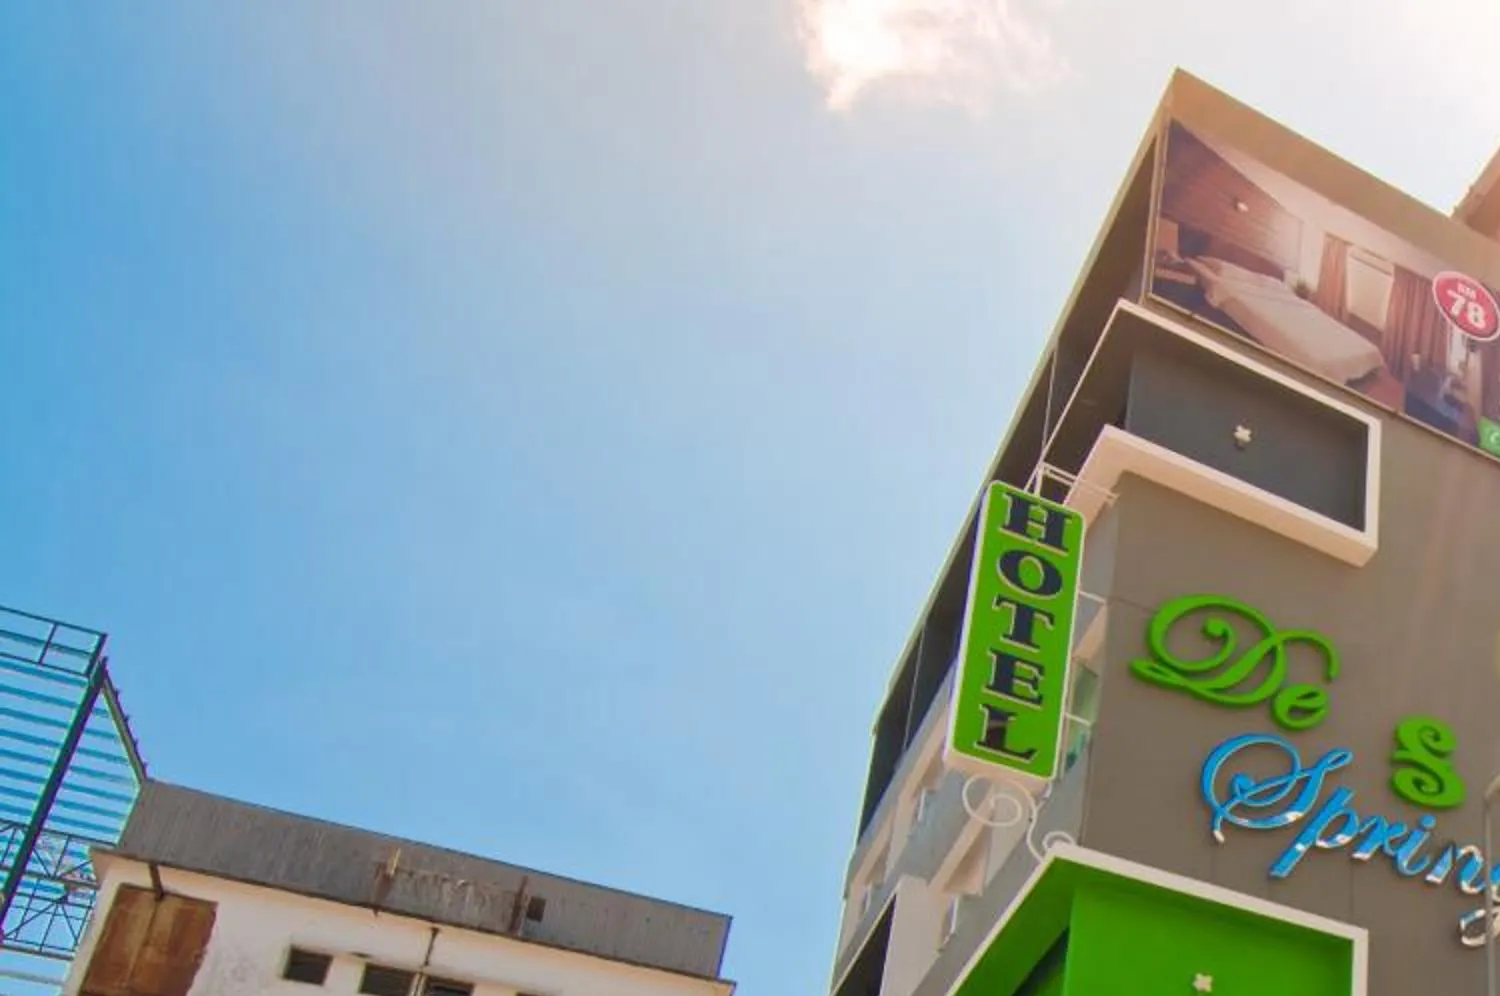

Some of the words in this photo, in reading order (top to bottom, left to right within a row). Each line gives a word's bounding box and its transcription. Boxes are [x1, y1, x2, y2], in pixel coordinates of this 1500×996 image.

[1447, 288, 1487, 330] 78
[973, 491, 1075, 764] HOTEL
[1129, 593, 1340, 731] De
